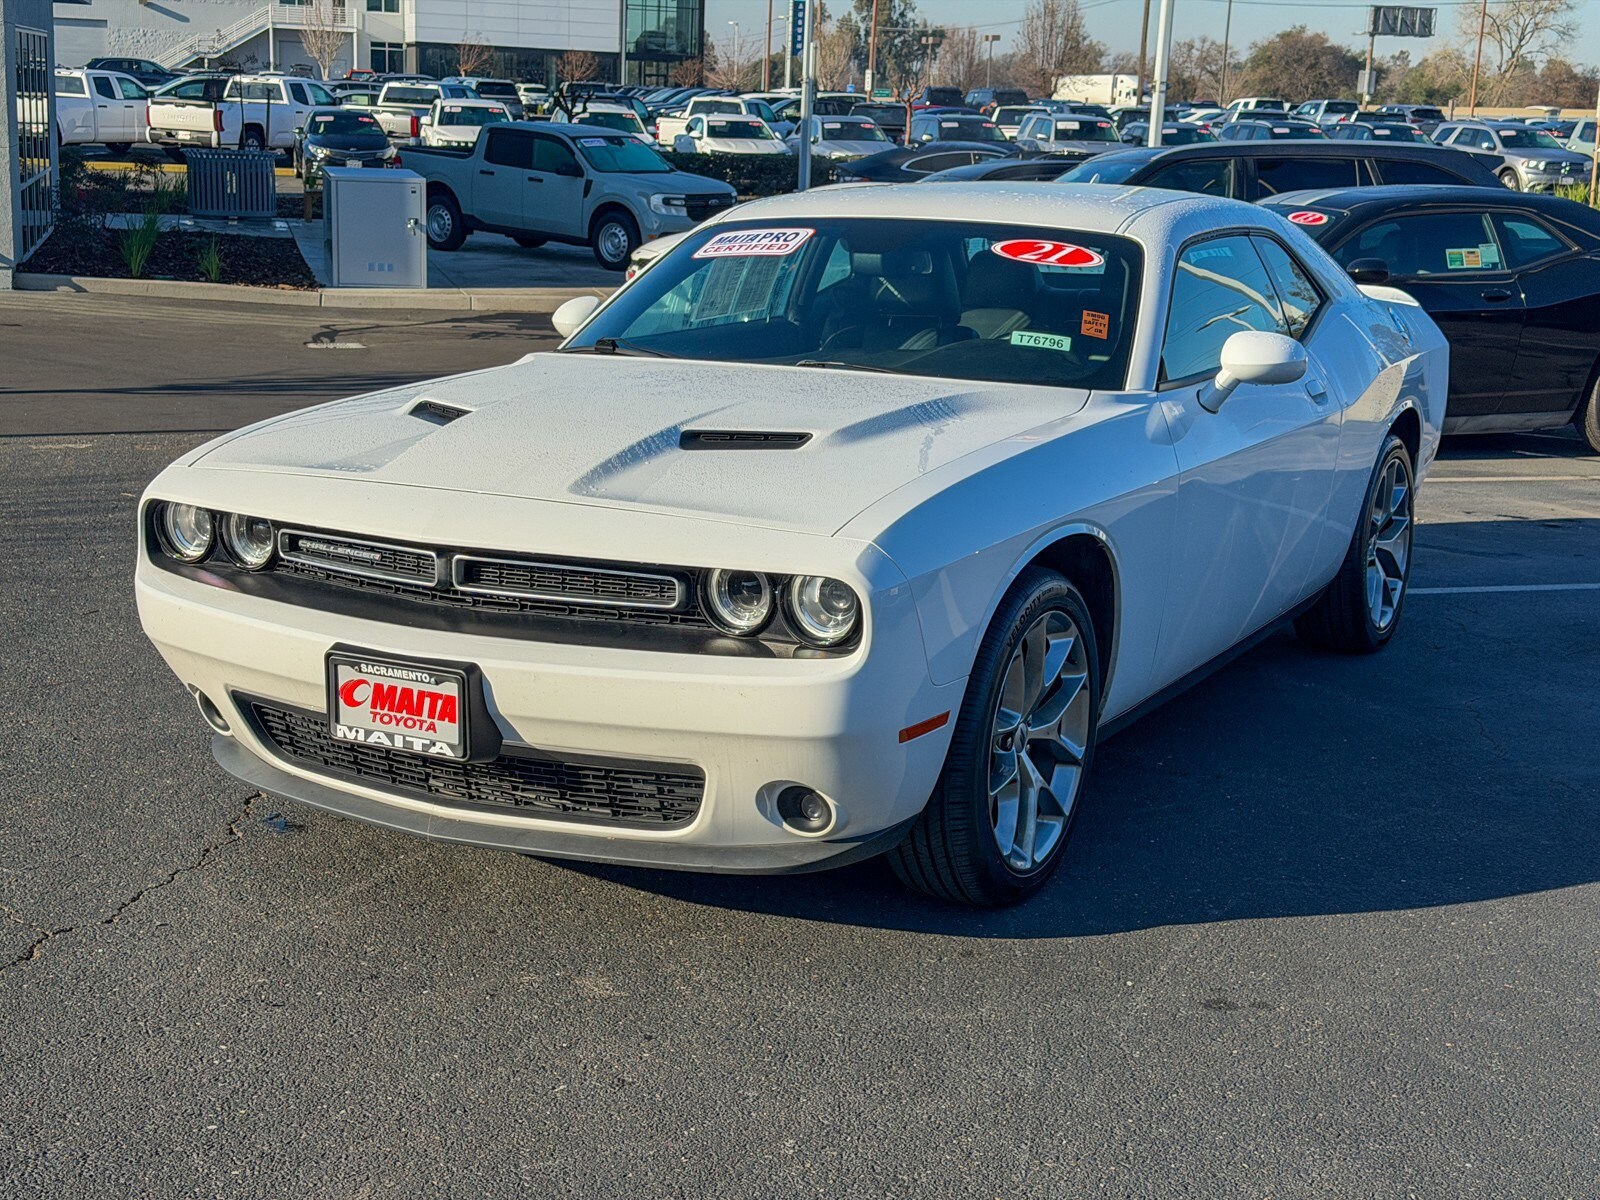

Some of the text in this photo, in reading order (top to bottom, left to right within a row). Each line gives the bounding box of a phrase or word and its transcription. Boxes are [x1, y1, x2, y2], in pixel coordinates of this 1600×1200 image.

[702, 243, 790, 254] CERTIFIED
[1016, 243, 1077, 262] 21
[1084, 319, 1107, 328] SAFETY
[1018, 333, 1064, 349] T76796
[298, 539, 381, 561] CHALLENGER
[1007, 594, 1042, 647] VELOCITY
[360, 663, 430, 684] SACRAMENTO
[370, 682, 457, 724] MAITA
[369, 711, 437, 733] TOYOTA
[336, 724, 455, 757] MAITA
